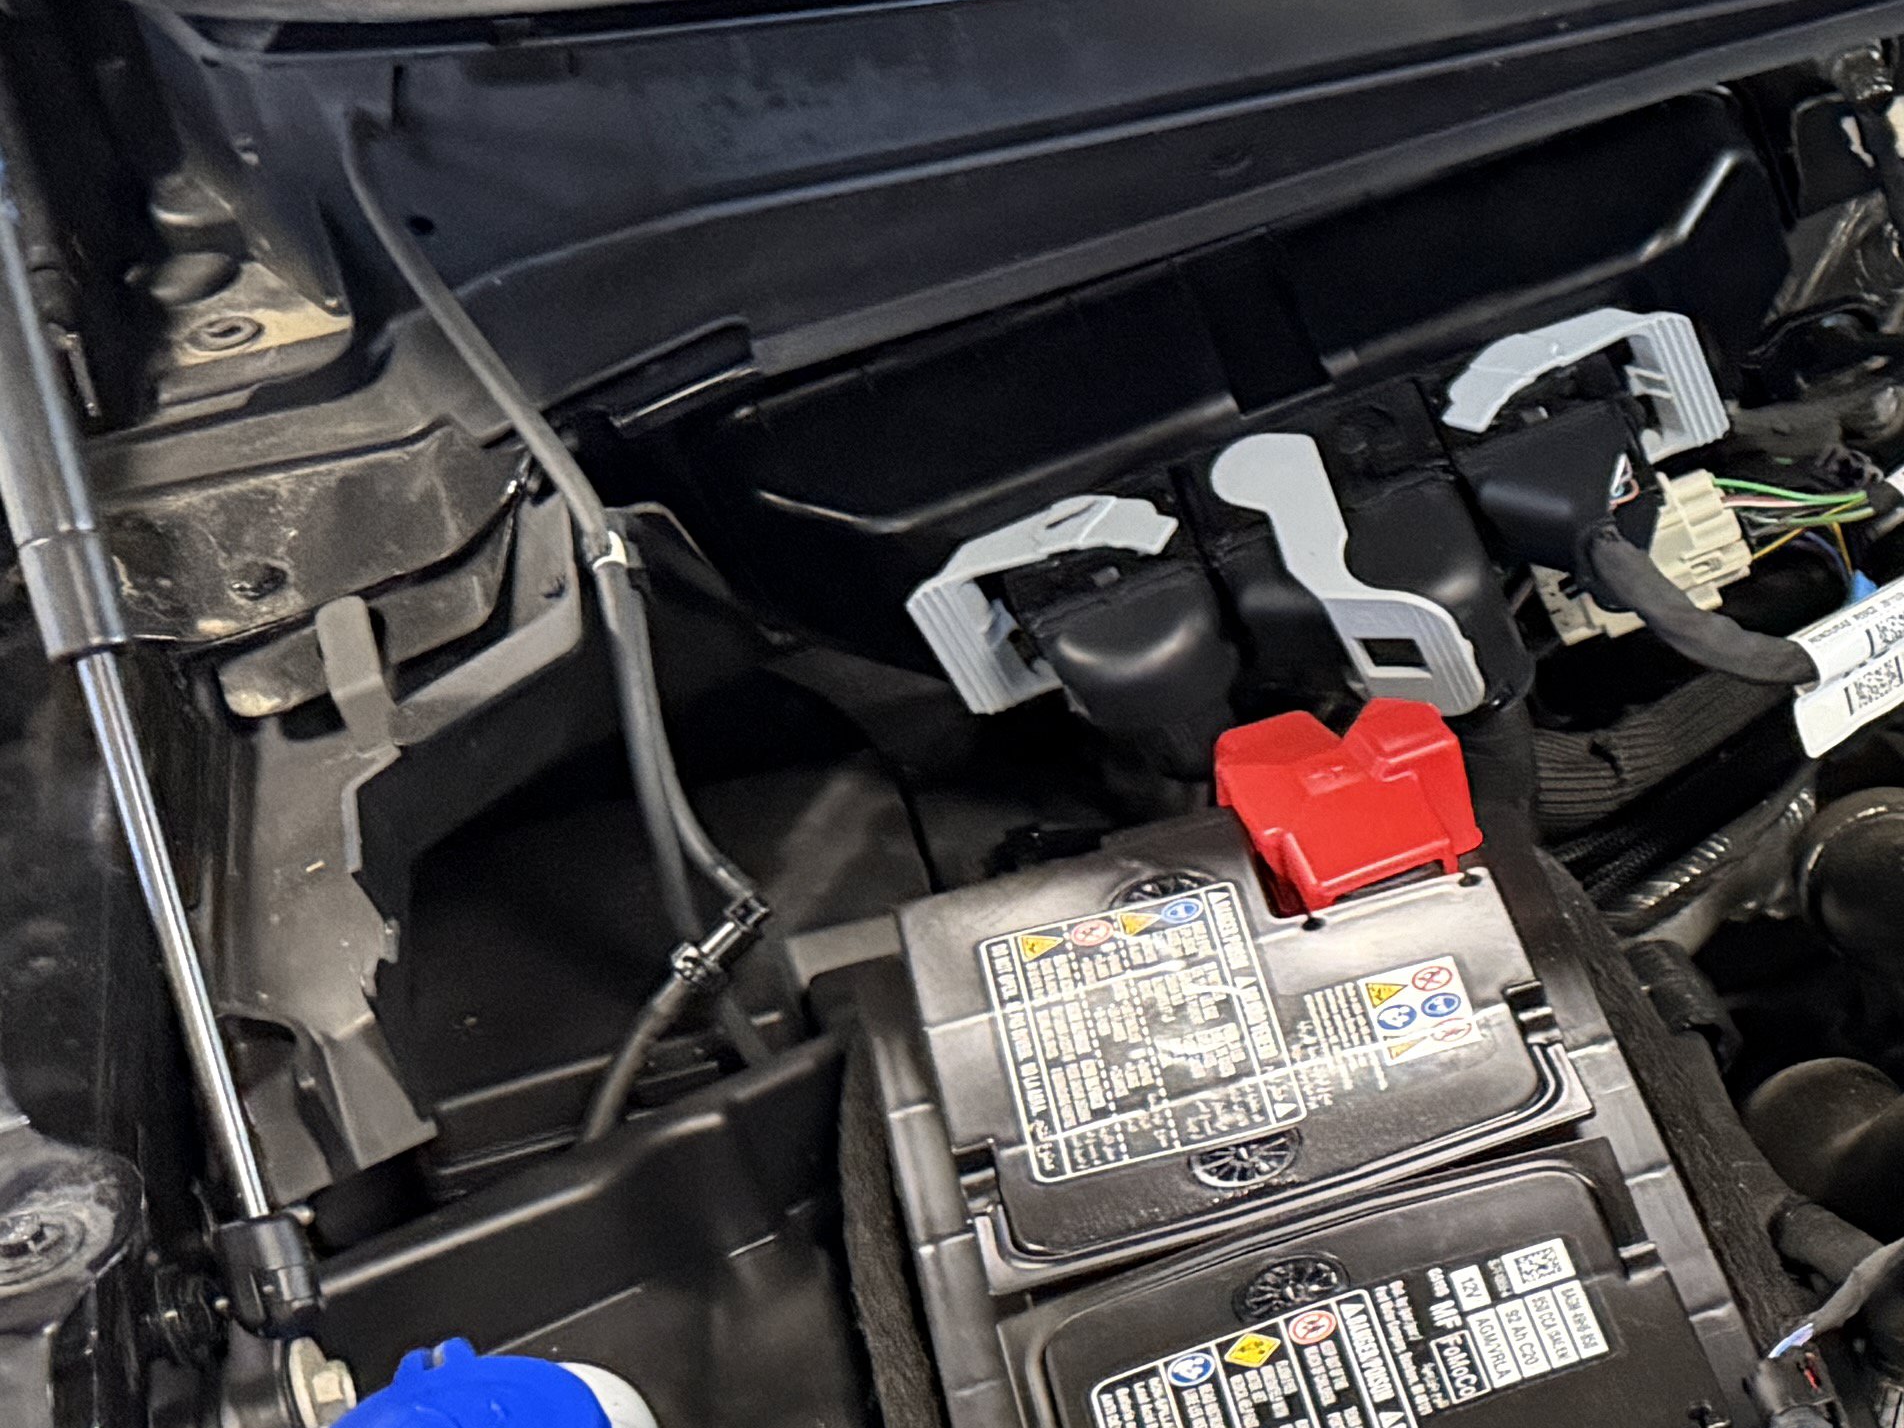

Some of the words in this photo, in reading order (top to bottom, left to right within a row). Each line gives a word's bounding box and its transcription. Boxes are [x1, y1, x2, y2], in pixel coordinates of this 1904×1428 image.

[1461, 1277, 1481, 1297] 12V
[1430, 1300, 1462, 1328] MF
[1512, 1326, 1527, 1341] Ah
[1477, 1319, 1510, 1378] AGM/VRLA
[1519, 1343, 1539, 1365] C20
[1436, 1334, 1481, 1398] FoMoCo
